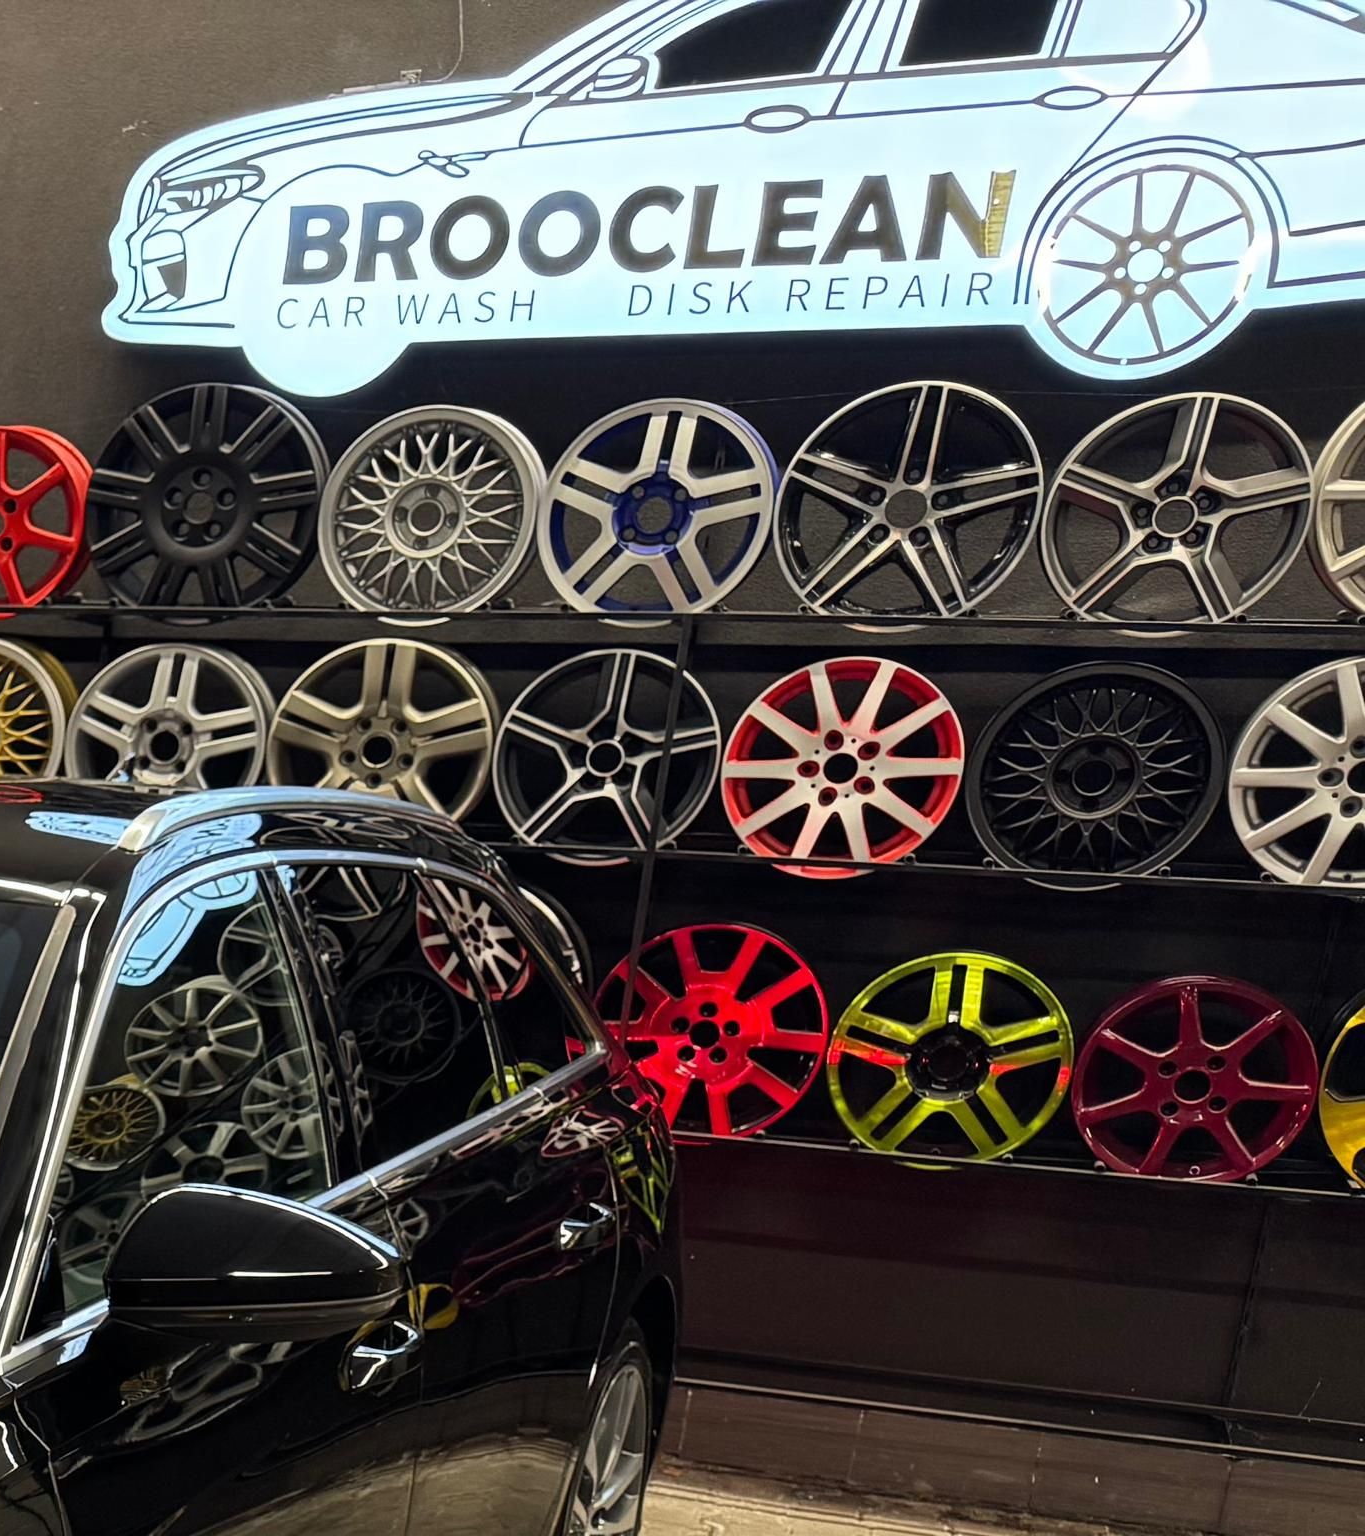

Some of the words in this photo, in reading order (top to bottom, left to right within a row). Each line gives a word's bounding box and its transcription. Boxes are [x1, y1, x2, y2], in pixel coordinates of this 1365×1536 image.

[282, 169, 1017, 285] BROOCLEAN
[276, 295, 366, 329] CAR
[396, 289, 536, 325] WASH
[627, 279, 754, 317] DISK
[785, 271, 994, 313] REPAIR
